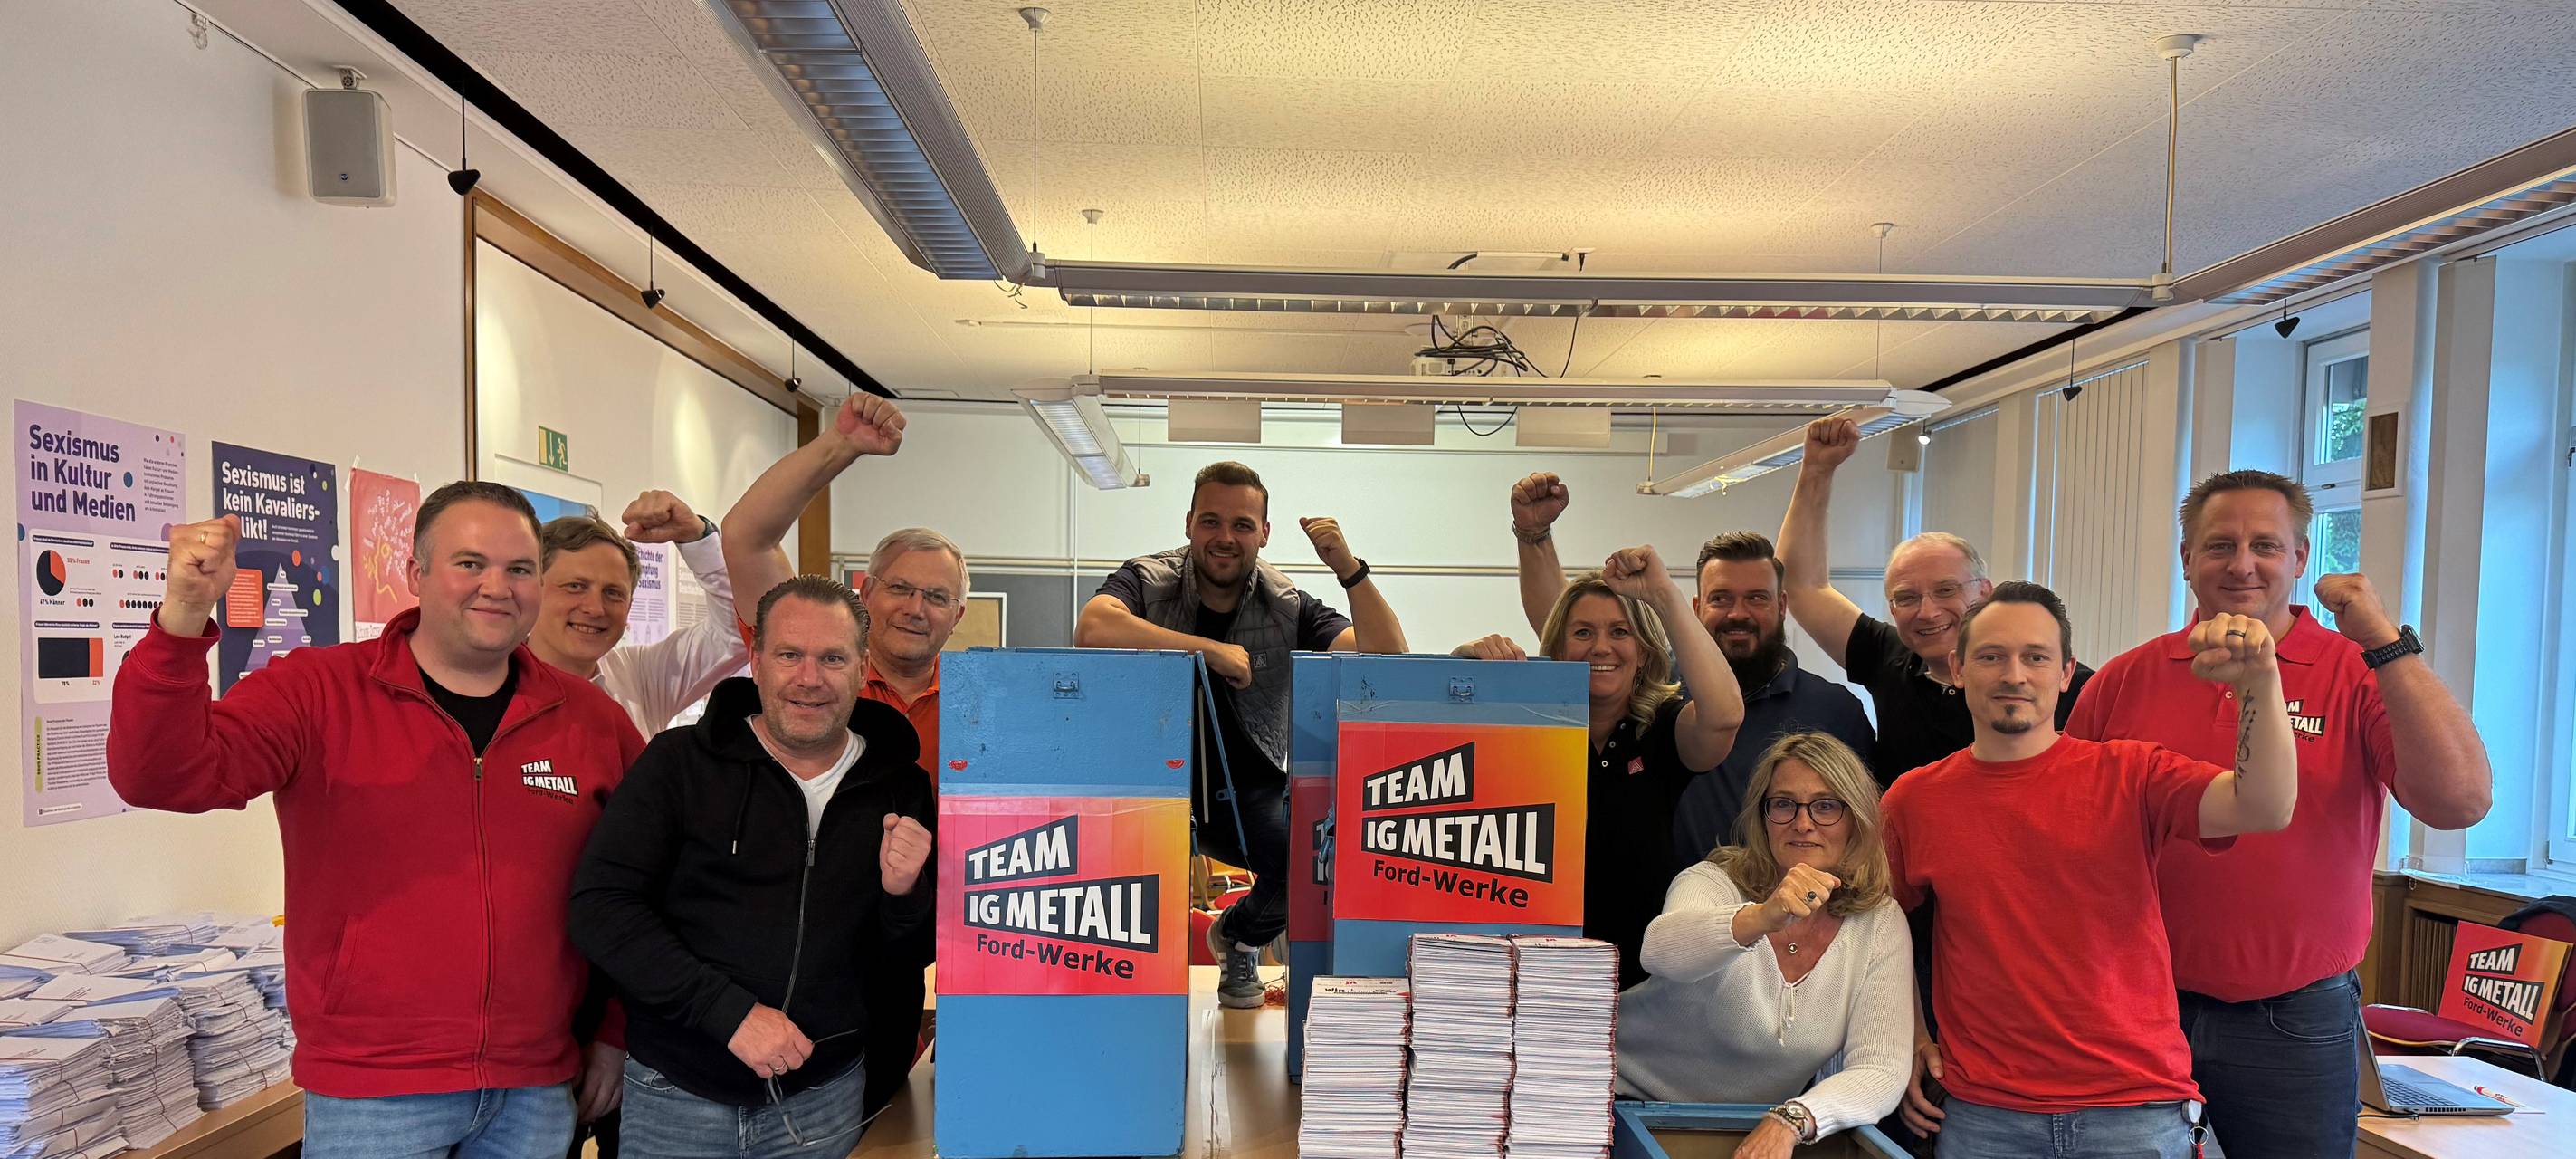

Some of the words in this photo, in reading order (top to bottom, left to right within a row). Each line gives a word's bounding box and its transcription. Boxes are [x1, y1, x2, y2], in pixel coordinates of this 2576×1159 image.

[29, 424, 119, 464] Sexismus
[31, 454, 48, 481] in
[54, 457, 112, 490] Kultur
[222, 461, 287, 492] Sexismus
[289, 472, 305, 495] ist
[31, 489, 67, 513] und
[72, 490, 136, 522] Medien
[223, 487, 253, 512] kein
[255, 492, 320, 521] Kavaliers-
[241, 515, 268, 541] likt!
[520, 760, 552, 773] TEAM
[523, 776, 535, 786] IG
[535, 776, 577, 795] METALL
[1367, 752, 1466, 806] TEAM
[968, 825, 1071, 880] TEAM
[1367, 819, 1397, 851] IG
[1401, 811, 1546, 875] METALL
[1373, 859, 1529, 908] Ford-Werke
[969, 894, 1000, 925] IG
[1005, 882, 1150, 944] METALL
[977, 934, 1135, 979] Ford-Werke
[2469, 947, 2515, 972] TEAM
[2463, 997, 2524, 1037] Ford-Werke
[2464, 976, 2478, 993] IG
[2477, 978, 2539, 1020] METALL
